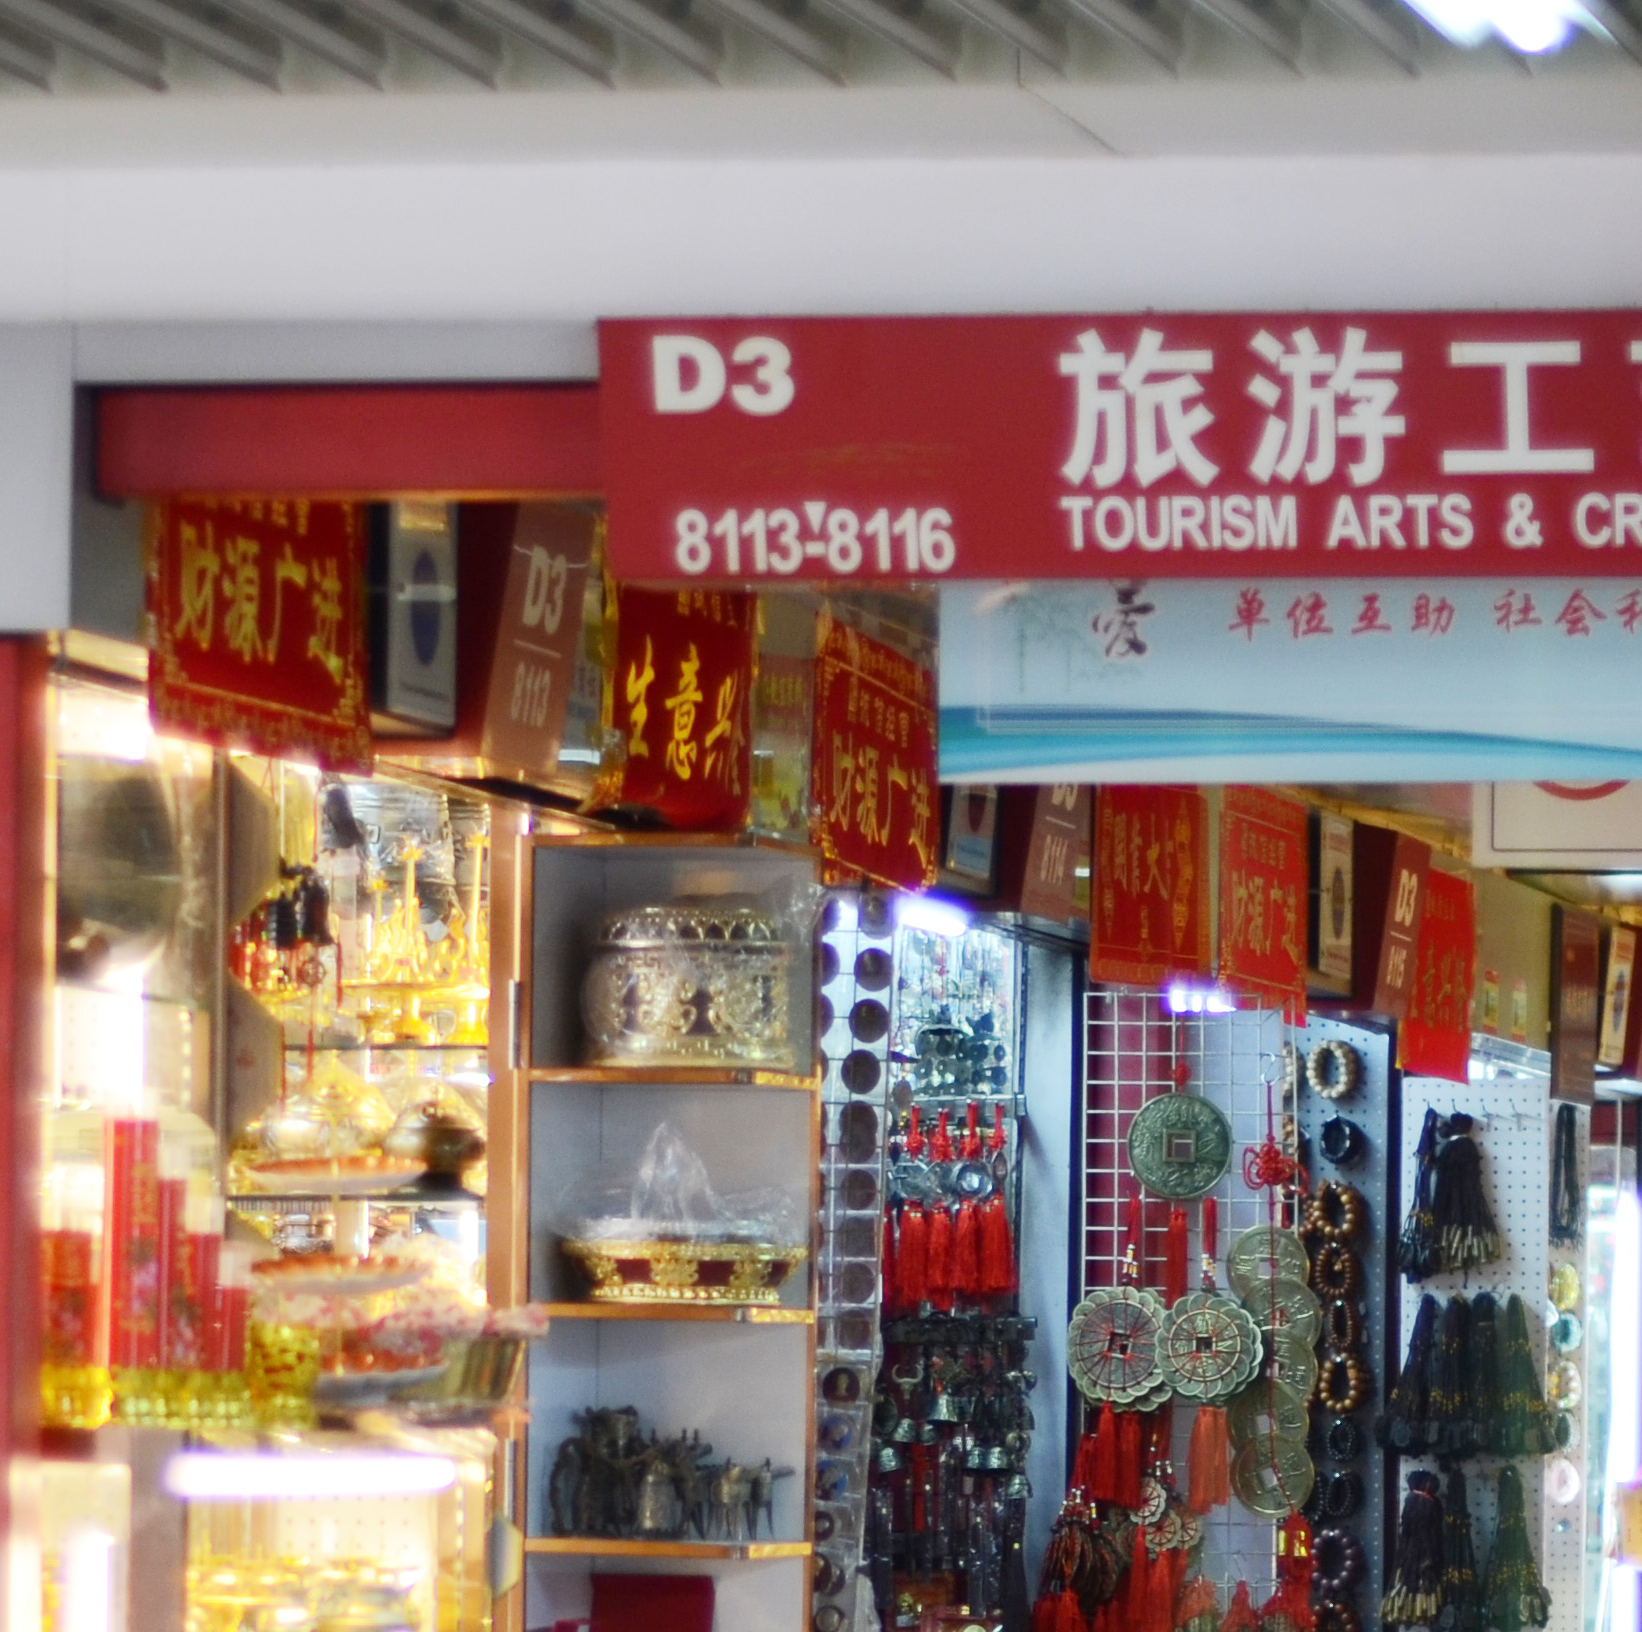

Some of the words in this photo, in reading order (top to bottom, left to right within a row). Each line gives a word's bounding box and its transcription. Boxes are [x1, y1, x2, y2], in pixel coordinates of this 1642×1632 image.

[650, 334, 795, 416] D3
[674, 506, 957, 574] 8113-8116
[1060, 494, 1298, 552] TOURISM
[1326, 493, 1474, 550] ARTS
[1503, 493, 1544, 549] &
[521, 544, 568, 636] D3
[1229, 588, 1456, 642] 单位互助
[509, 661, 552, 729] 8113
[1394, 869, 1419, 927] D3
